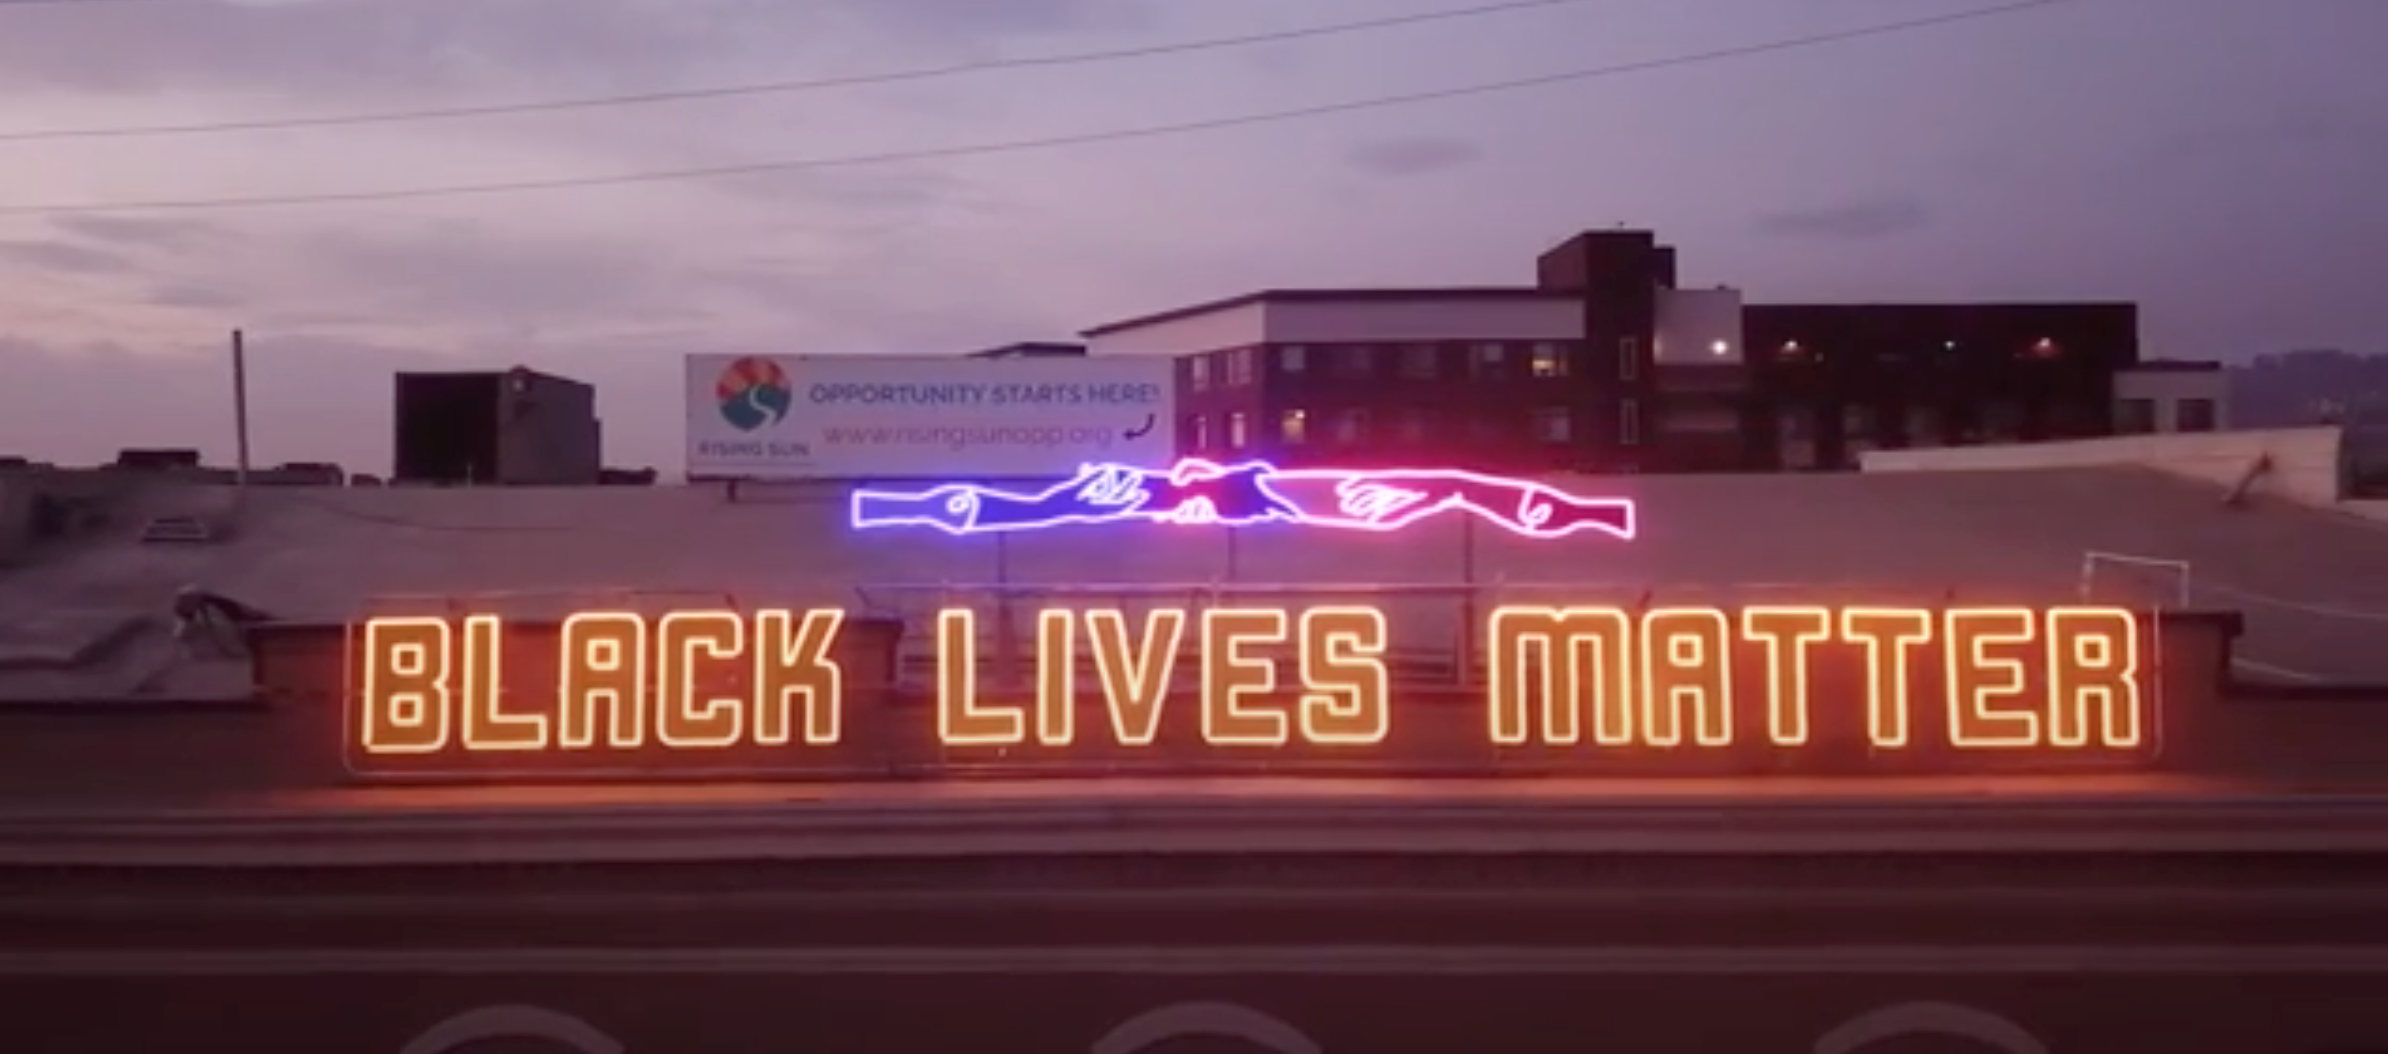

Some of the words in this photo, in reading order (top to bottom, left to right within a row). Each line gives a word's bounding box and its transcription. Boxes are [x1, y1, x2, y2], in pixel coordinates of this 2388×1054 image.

[809, 383, 986, 404] OPPORTUNITY
[991, 382, 1083, 403] STARTS
[1088, 382, 1161, 402] HERE!
[698, 441, 762, 456] RISING
[767, 442, 810, 456] SUN
[362, 608, 845, 753] BLACK
[937, 605, 1389, 746] LIVES
[1489, 606, 2140, 748] MATTER
